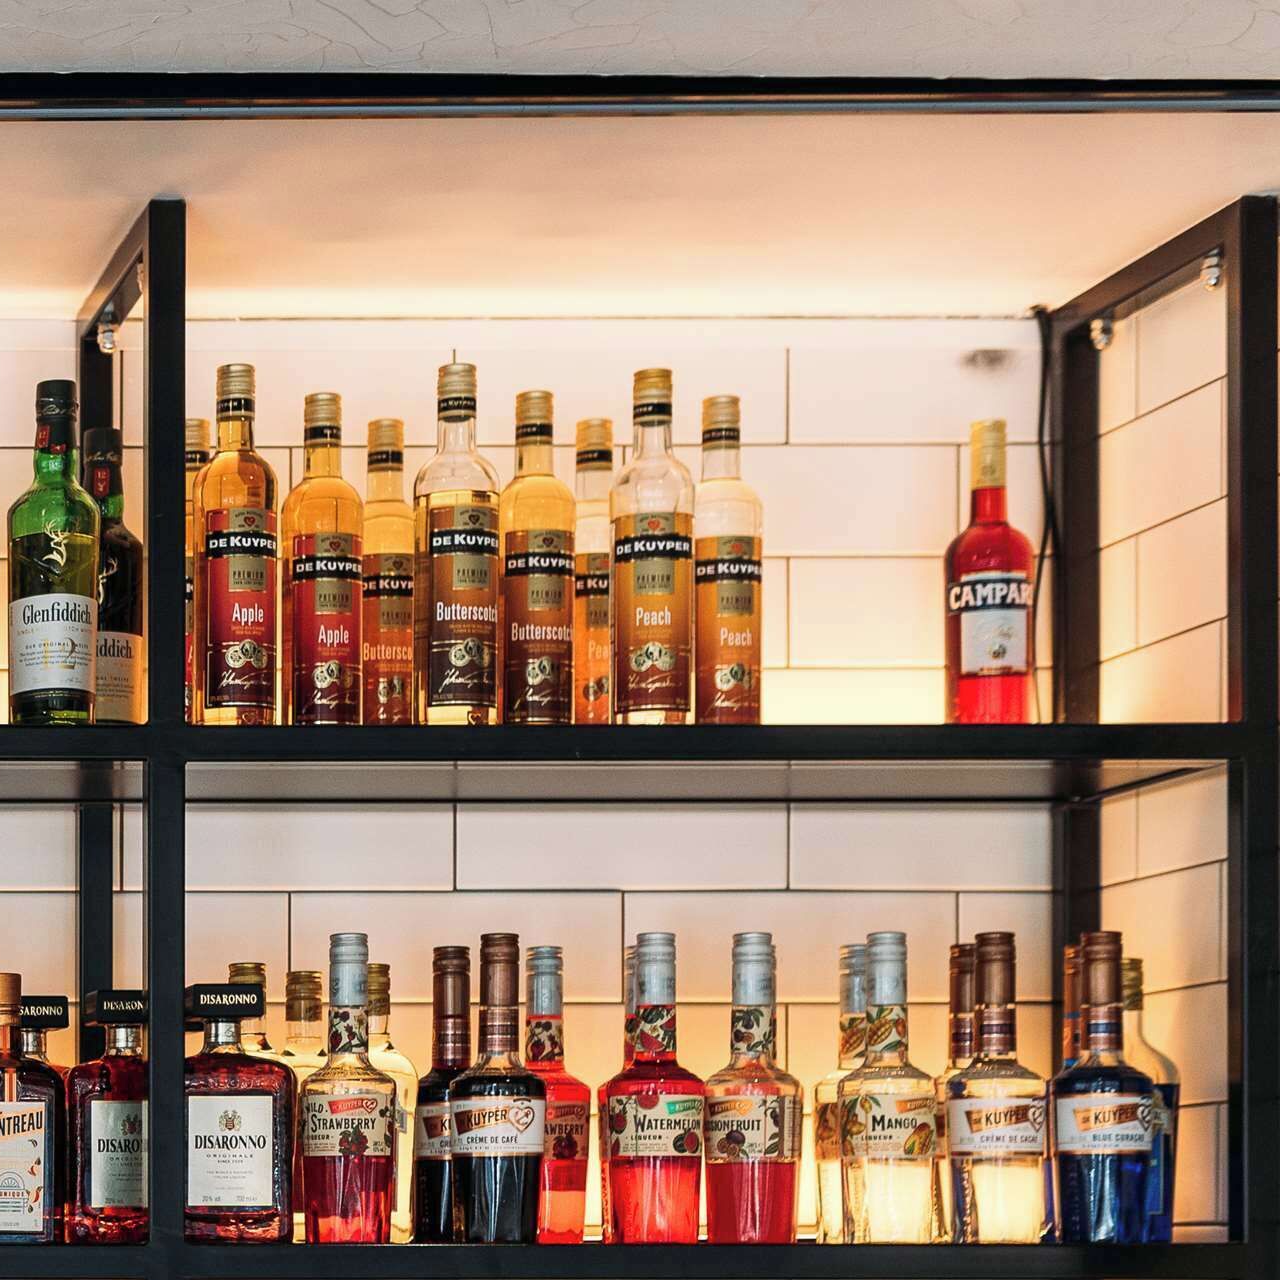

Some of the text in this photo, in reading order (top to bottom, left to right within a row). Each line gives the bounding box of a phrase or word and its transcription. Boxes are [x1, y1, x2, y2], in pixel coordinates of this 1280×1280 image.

[209, 538, 227, 549] DE
[634, 540, 690, 552] KUYPER
[22, 600, 90, 626] Glenfiddich
[232, 602, 264, 625] Apple
[636, 606, 672, 627] Peach
[318, 624, 349, 647] Apple
[720, 627, 752, 647] Peach
[199, 993, 258, 1006] DISARONNO
[311, 1113, 377, 1132] STRAWBERRY
[467, 1107, 507, 1128] KUYPER
[633, 1114, 701, 1133] WATERMELON
[871, 1114, 918, 1132] MANGO
[985, 1107, 1028, 1127] KUYPER
[1094, 1107, 1138, 1126] KUYPER
[194, 1135, 267, 1150] DISARONNO
